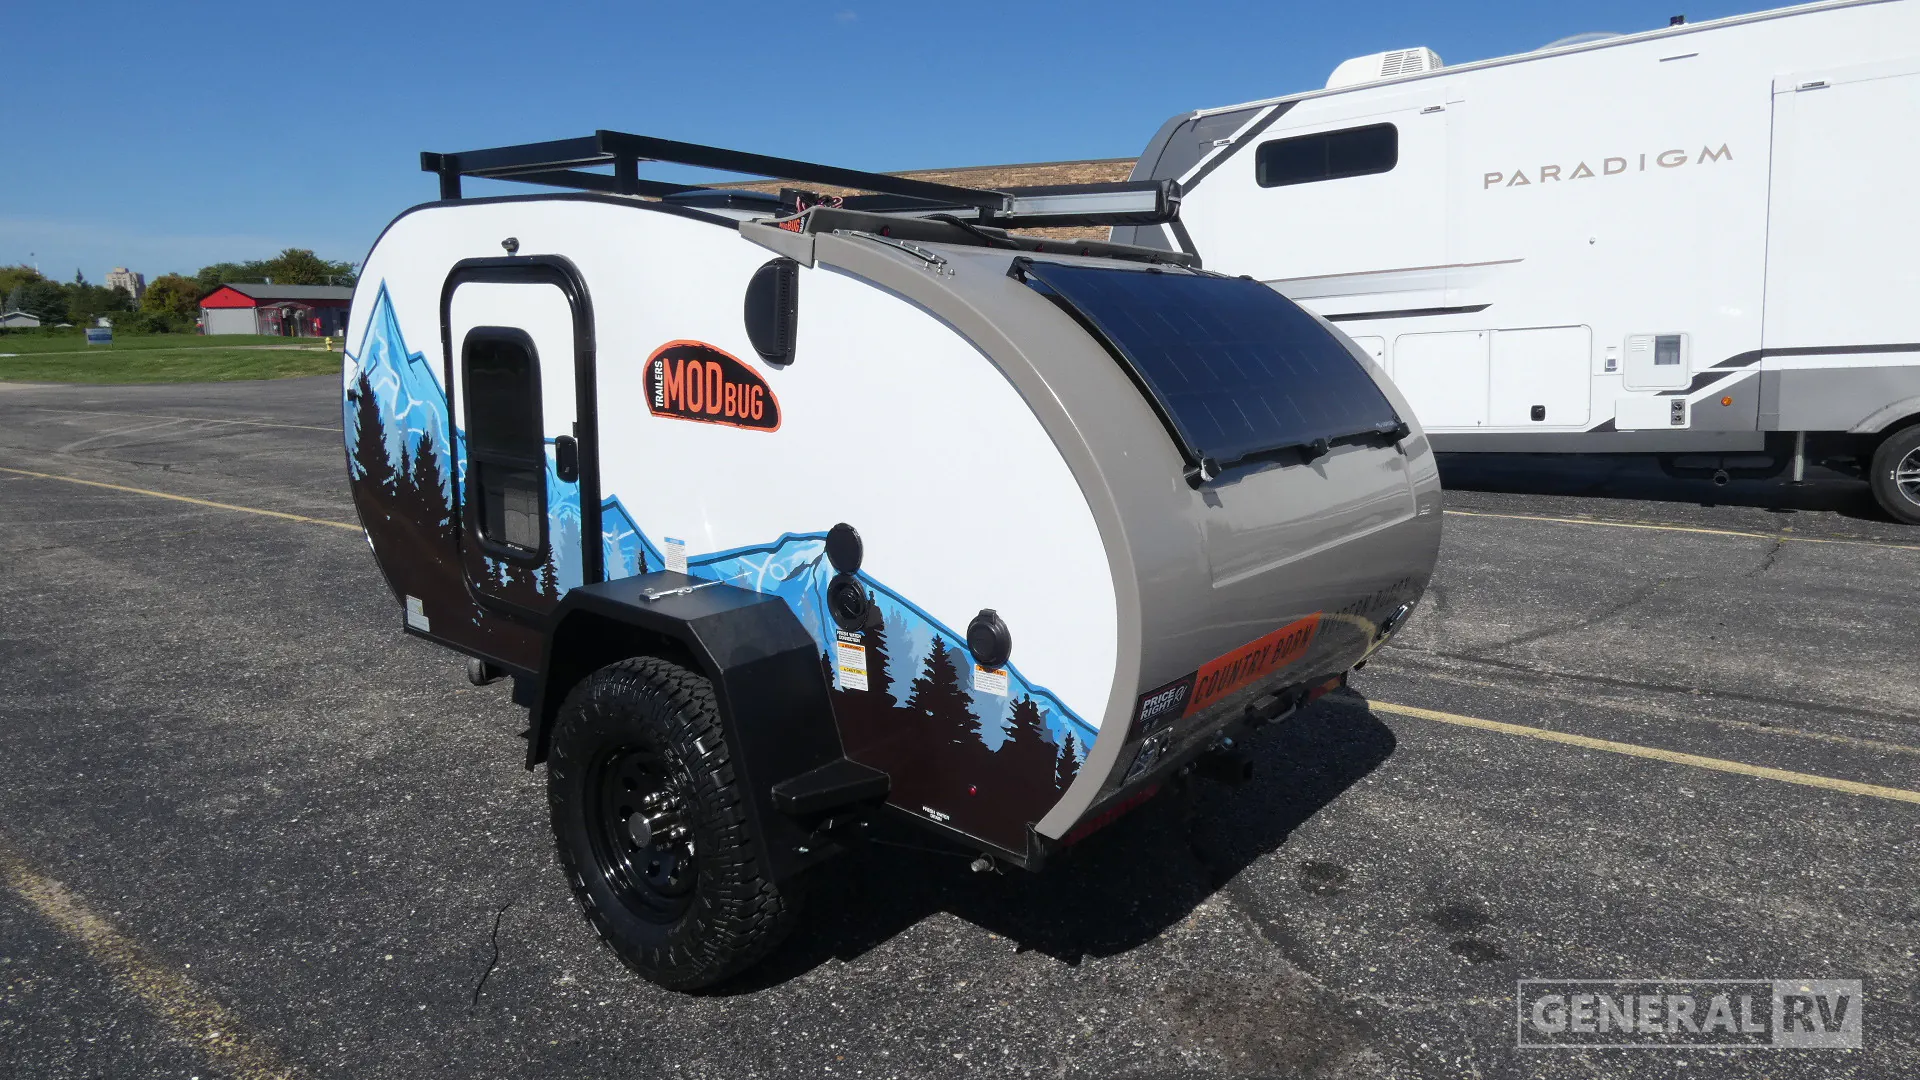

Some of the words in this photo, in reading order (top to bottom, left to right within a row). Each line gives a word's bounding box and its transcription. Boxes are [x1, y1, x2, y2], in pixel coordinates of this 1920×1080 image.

[1484, 143, 1733, 189] PARADIGM
[655, 360, 664, 408] TRAILERS
[1195, 644, 1271, 704] COUNTRY
[1271, 624, 1312, 664] BORN
[1140, 698, 1173, 720] RIGHT
[1143, 688, 1176, 710] PRICE
